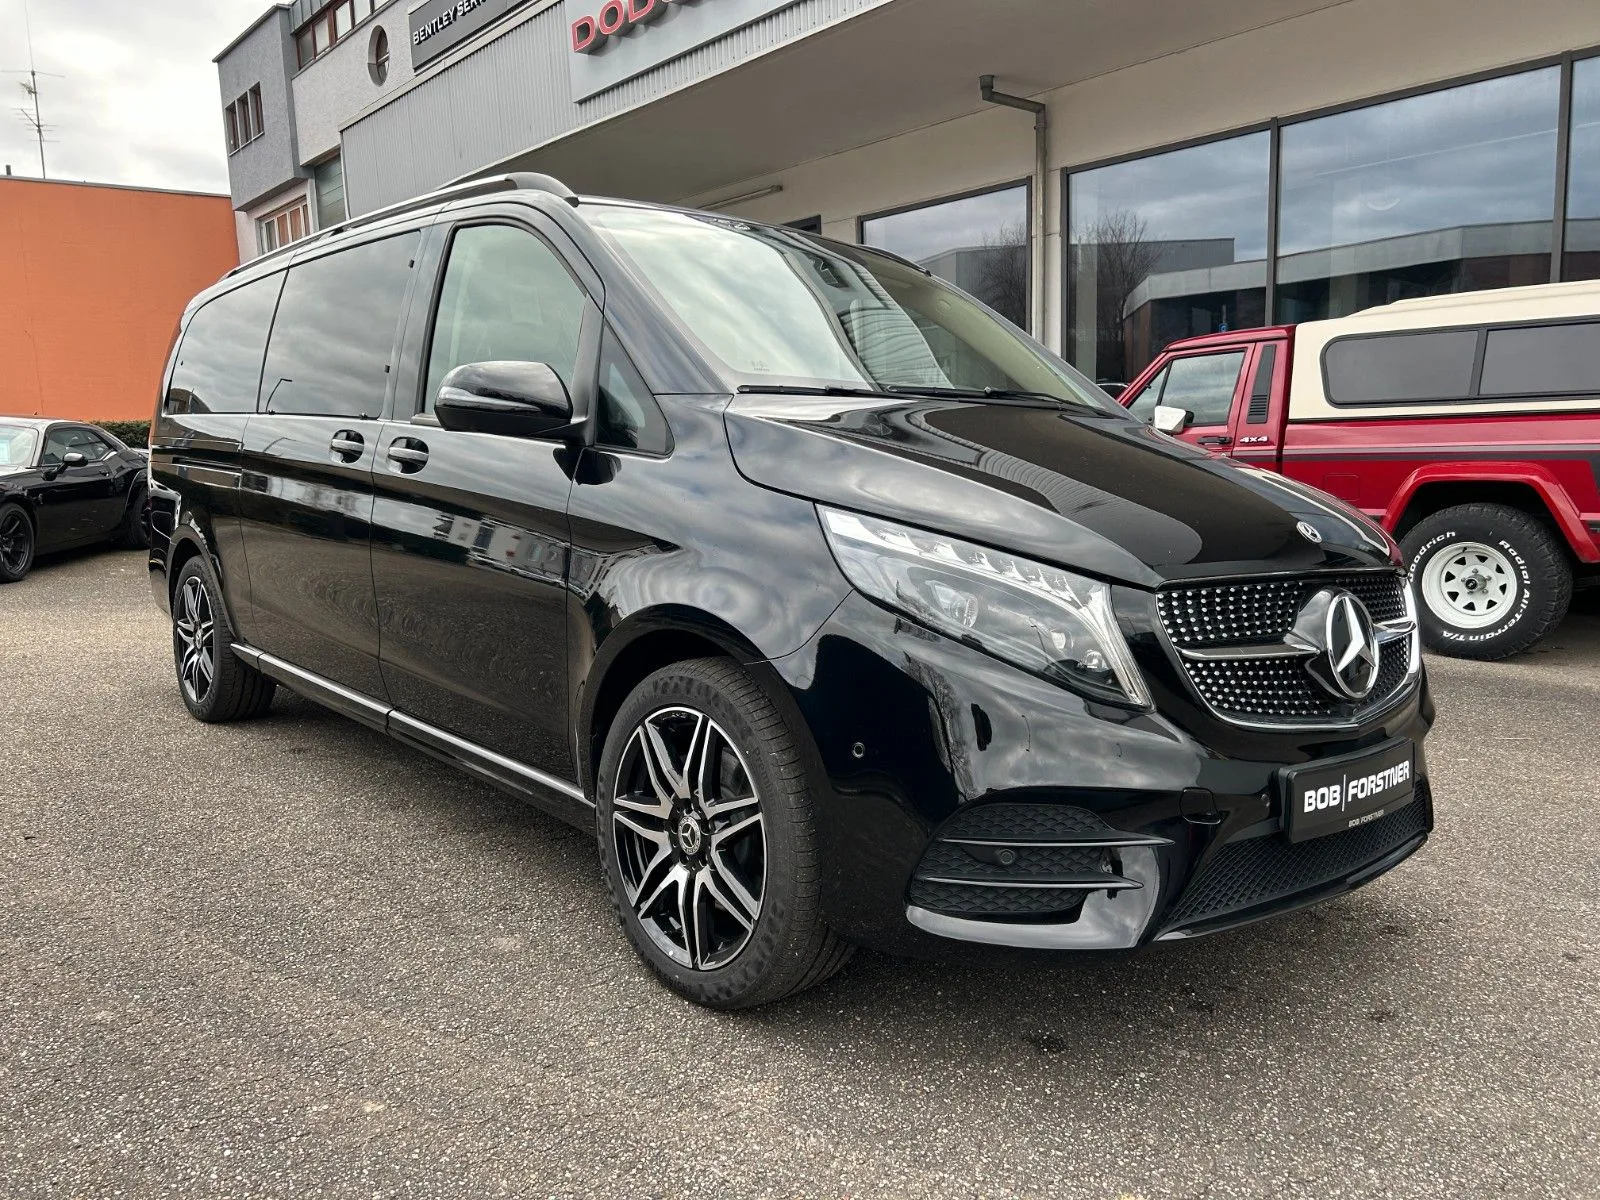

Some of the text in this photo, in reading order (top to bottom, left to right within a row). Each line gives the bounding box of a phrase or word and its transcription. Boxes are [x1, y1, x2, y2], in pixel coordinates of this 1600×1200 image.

[413, 0, 482, 45] BENTLEY SER
[572, 0, 672, 52] DOD
[1442, 540, 1531, 641] Radial All-Terrain T/A
[1303, 760, 1410, 813] BOB FORSTNER
